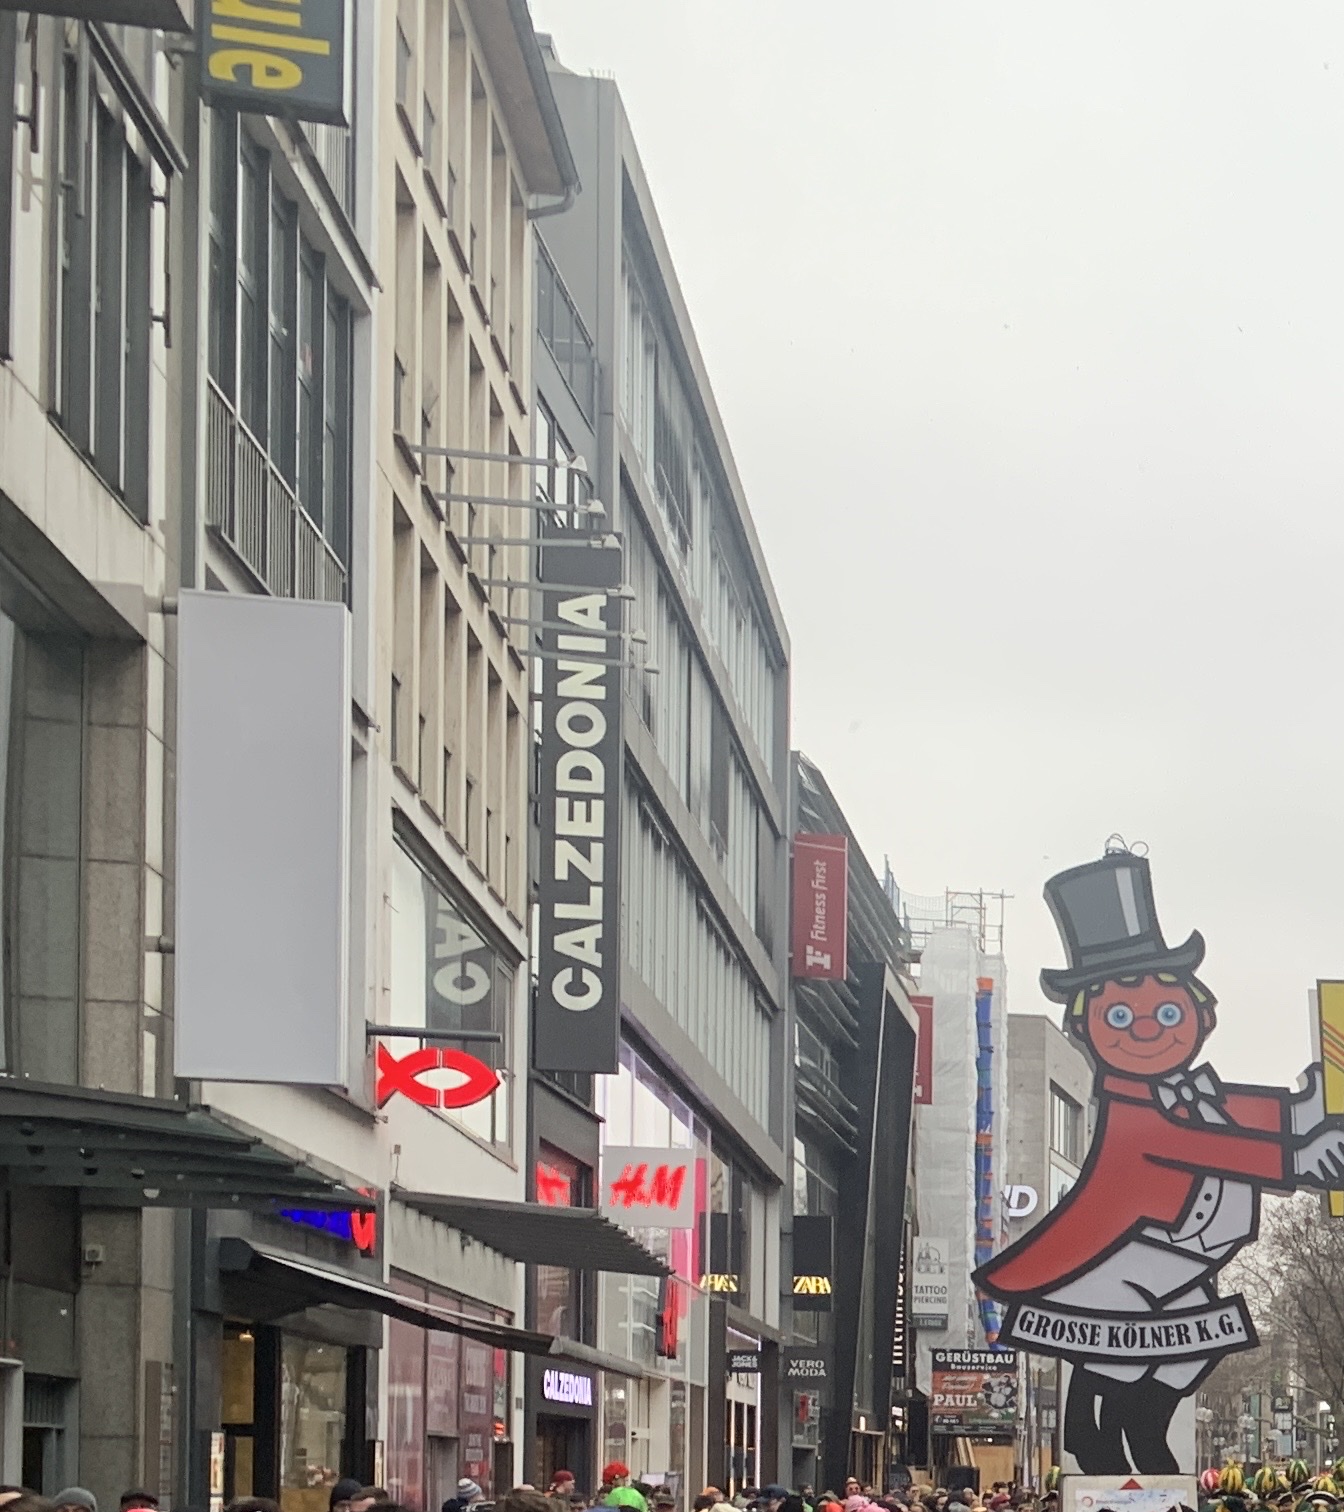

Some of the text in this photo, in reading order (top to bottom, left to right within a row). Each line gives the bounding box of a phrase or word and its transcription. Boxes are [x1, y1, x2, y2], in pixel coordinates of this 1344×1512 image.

[551, 593, 608, 1012] CALZEDONIA
[811, 859, 829, 943] fitness first
[609, 1163, 688, 1211] H&M
[793, 1275, 832, 1295] ZARA
[914, 1285, 948, 1296] TATTOO
[913, 1296, 947, 1305] PIERCING
[1018, 1310, 1243, 1349] GROSSE KÖLNER K.G.
[790, 1359, 825, 1369] VERO
[935, 1350, 1014, 1365] GERÜSTBAU
[787, 1367, 827, 1378] MODA
[543, 1368, 593, 1407] CALZEDONIA
[933, 1393, 978, 1408] PAUL
